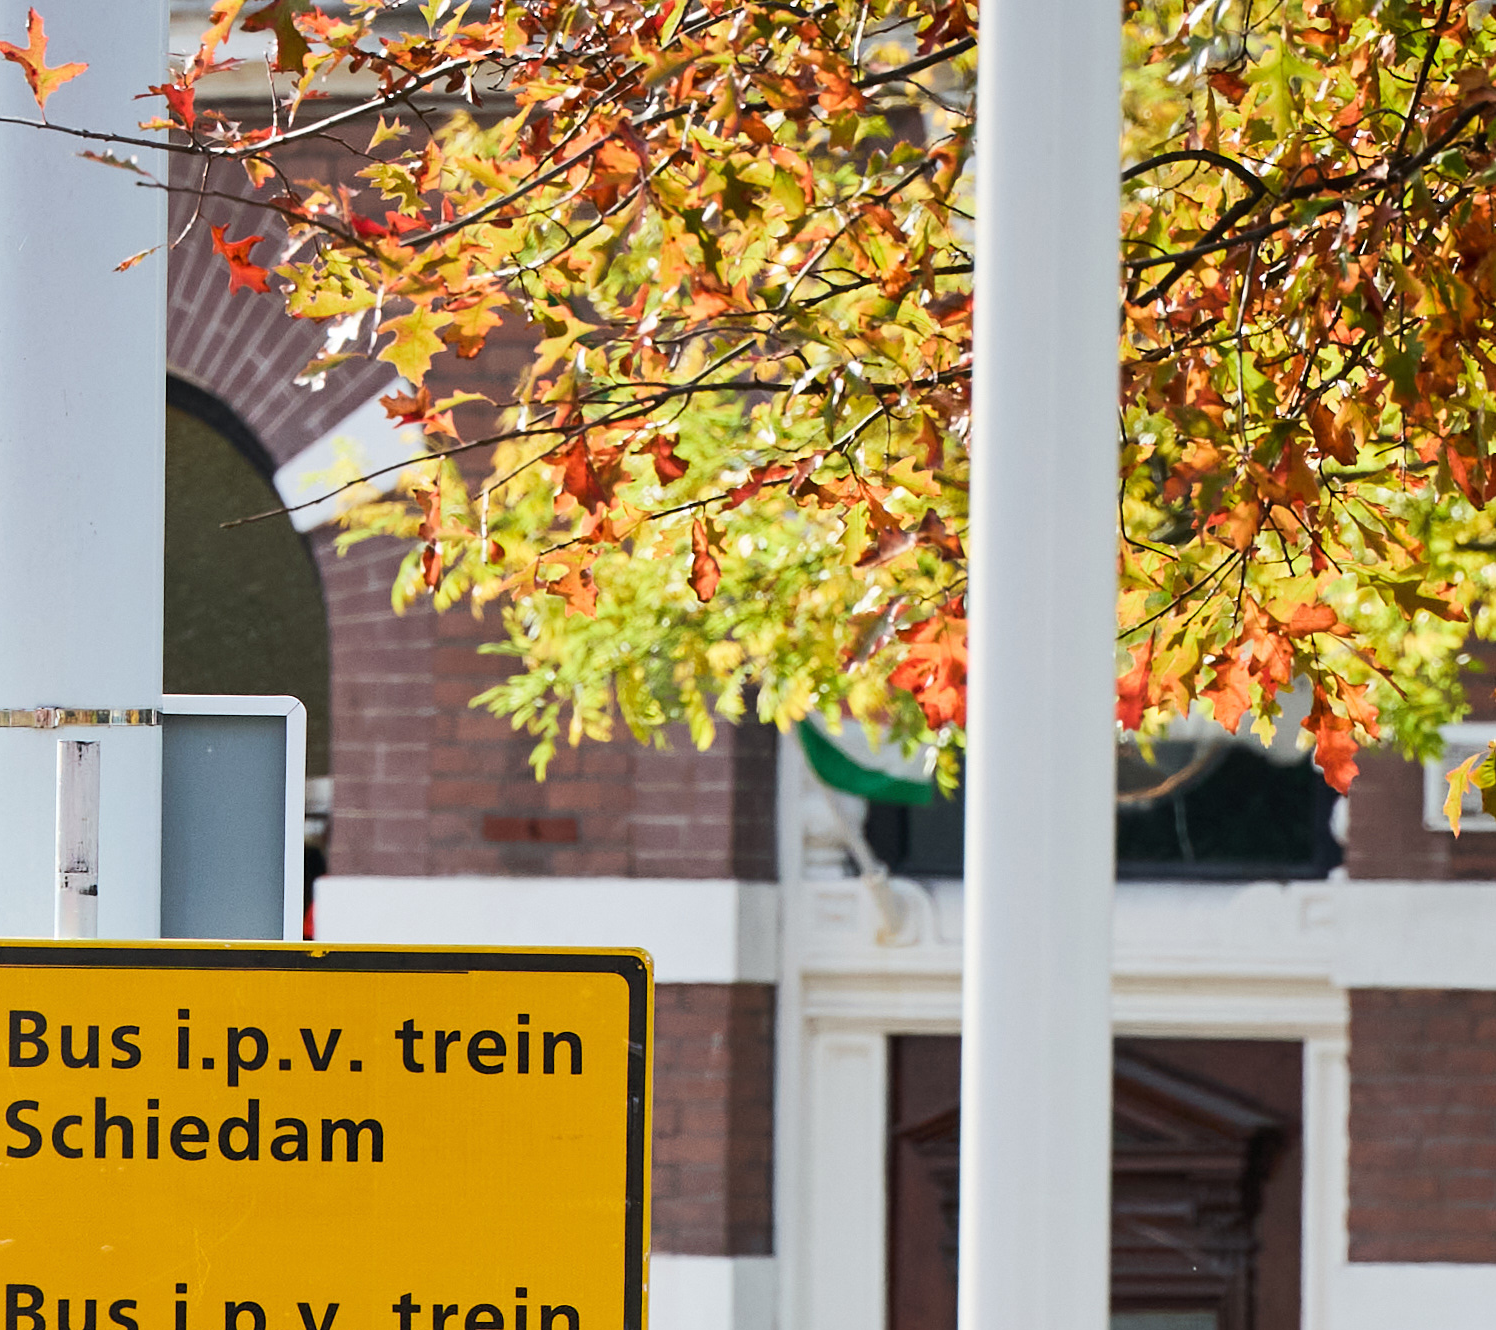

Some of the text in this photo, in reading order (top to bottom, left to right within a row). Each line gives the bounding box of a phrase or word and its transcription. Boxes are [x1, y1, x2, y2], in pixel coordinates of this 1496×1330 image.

[8, 1008, 583, 1088] Bus i.p.v. trein
[5, 1096, 384, 1163] Schiedam
